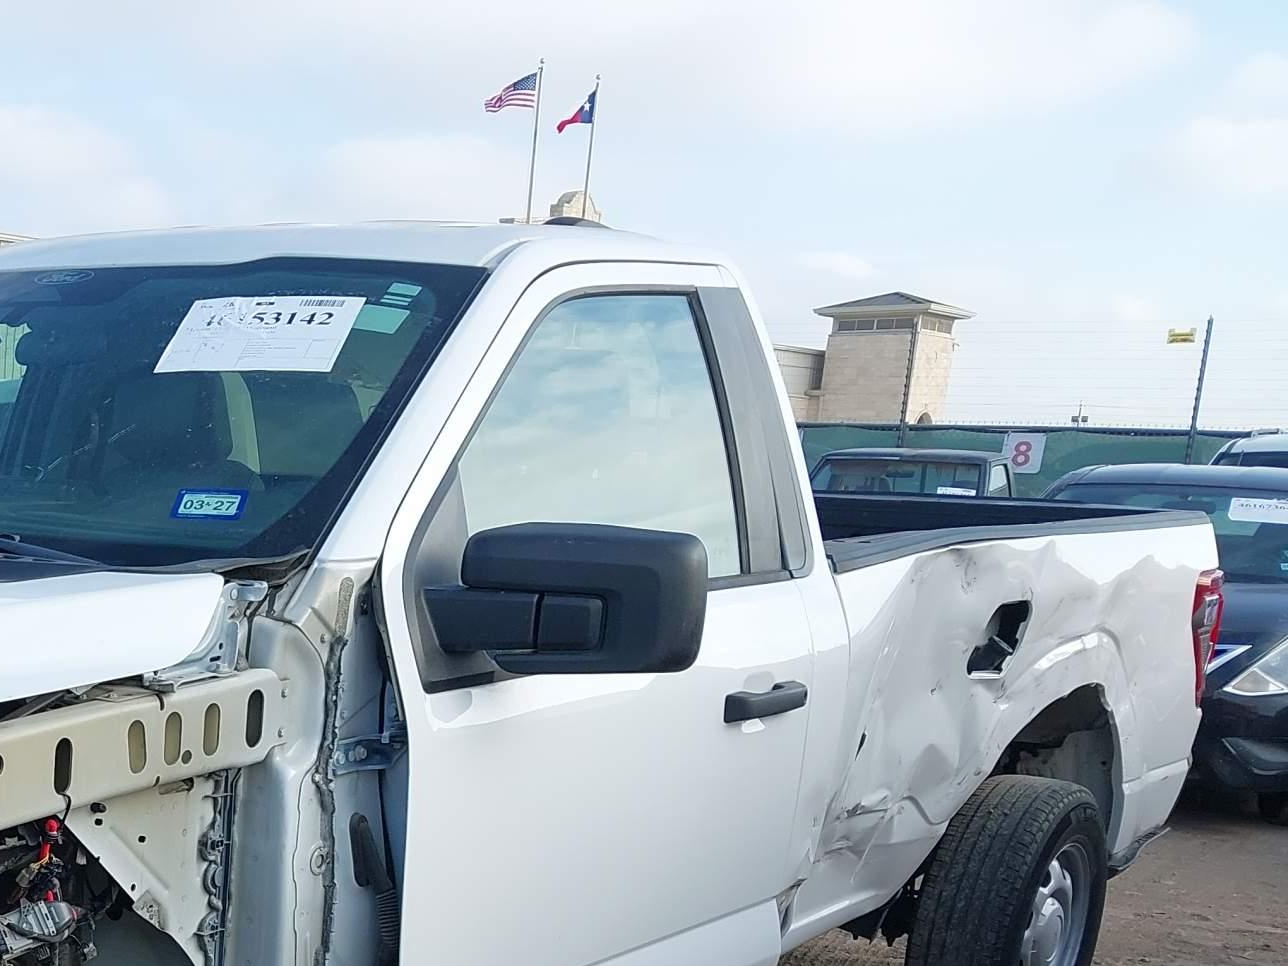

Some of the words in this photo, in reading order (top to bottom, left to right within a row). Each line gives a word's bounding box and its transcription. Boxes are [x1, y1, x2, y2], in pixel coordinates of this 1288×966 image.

[1012, 440, 1033, 467] 8
[183, 499, 205, 511] 03
[212, 500, 237, 512] 27
